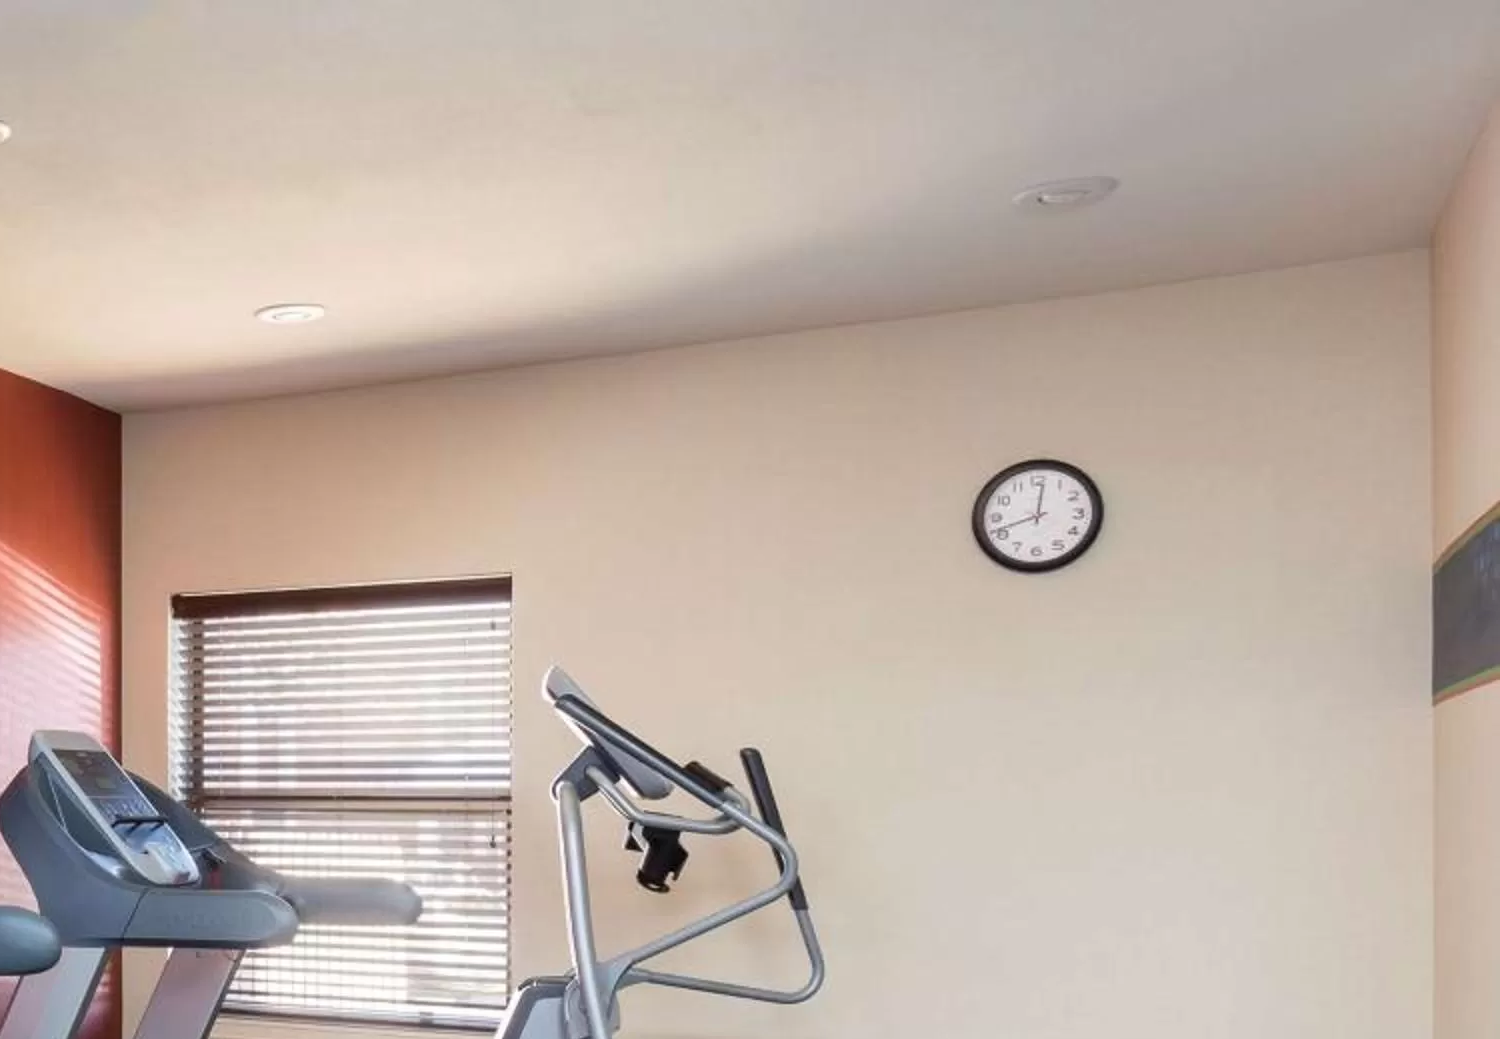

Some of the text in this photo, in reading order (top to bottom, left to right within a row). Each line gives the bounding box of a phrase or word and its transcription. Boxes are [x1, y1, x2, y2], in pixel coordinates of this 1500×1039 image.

[997, 495, 1011, 507] 10
[1072, 507, 1085, 520] 3
[1067, 525, 1079, 536] 4
[1051, 539, 1065, 551] 5
[1030, 546, 1042, 557] 6
